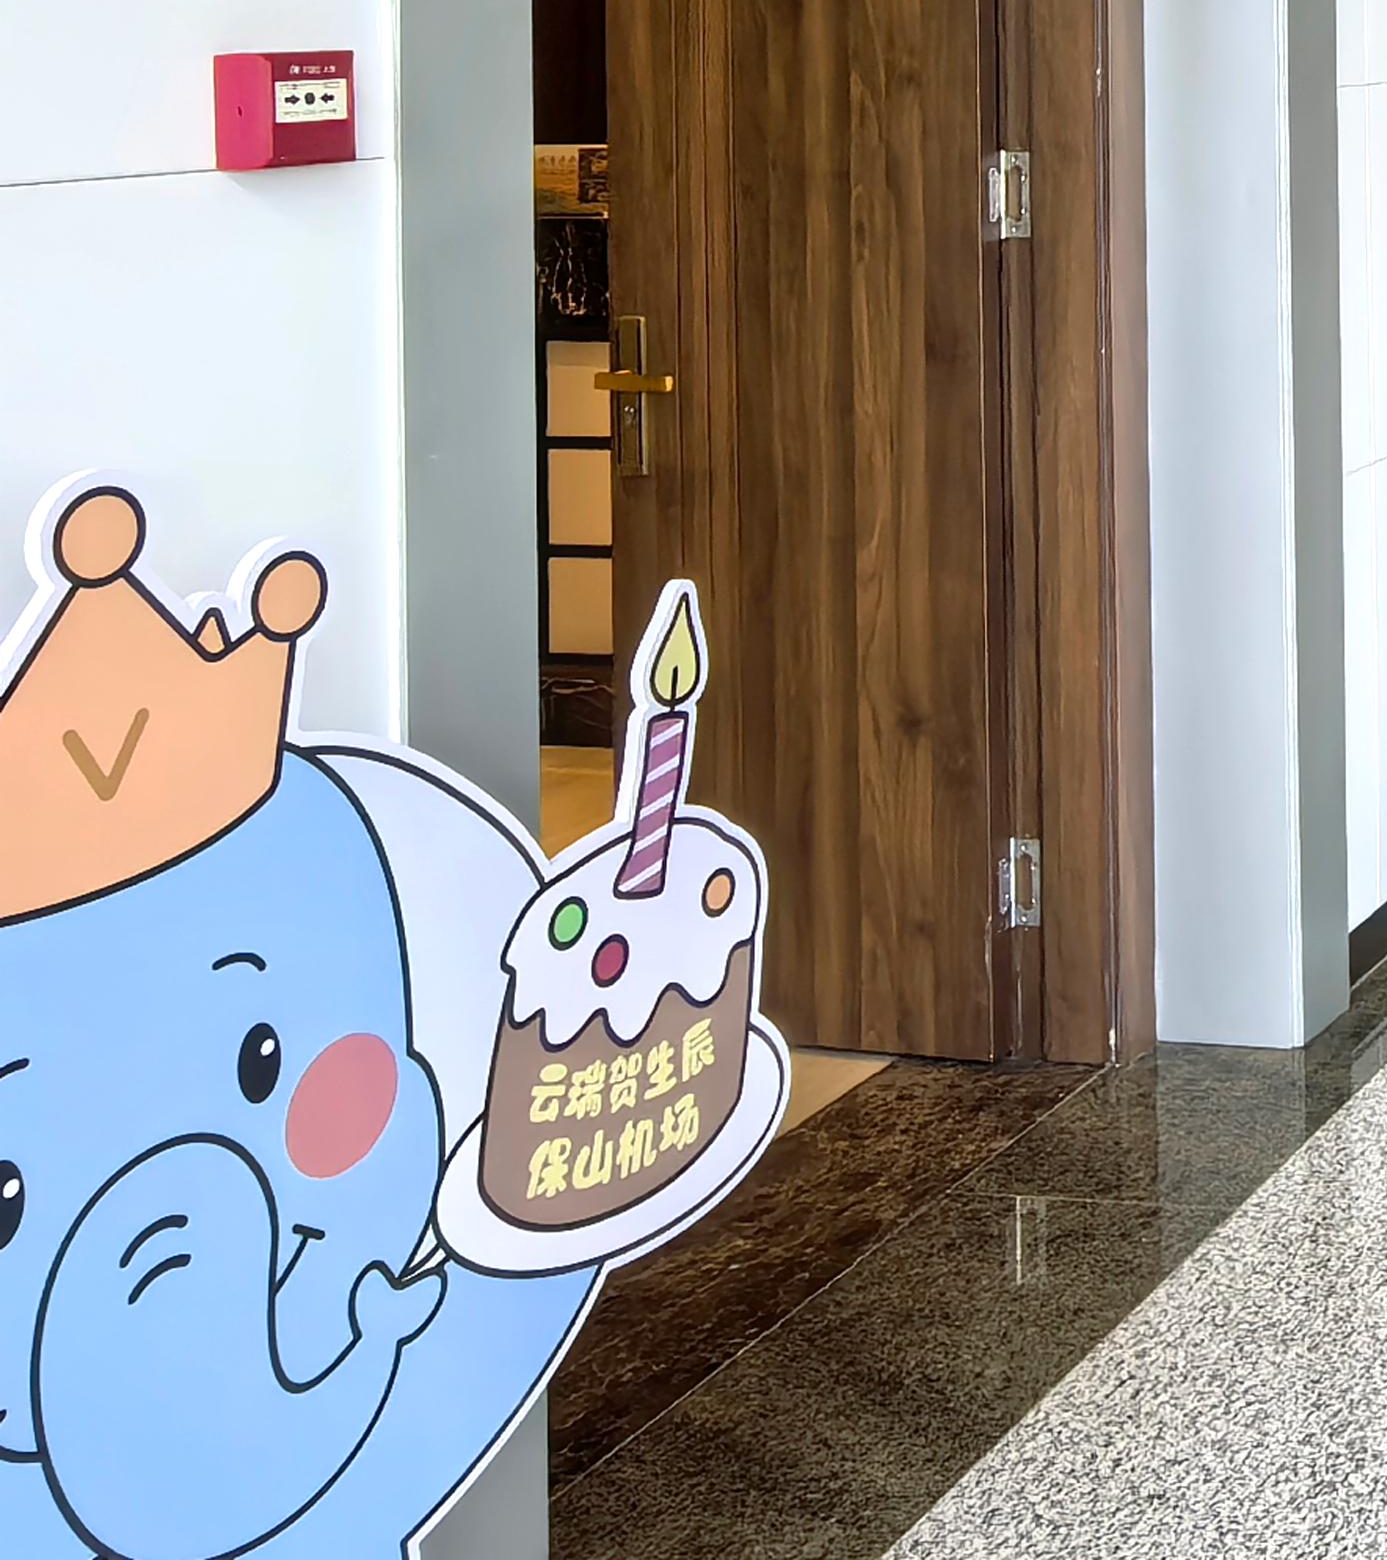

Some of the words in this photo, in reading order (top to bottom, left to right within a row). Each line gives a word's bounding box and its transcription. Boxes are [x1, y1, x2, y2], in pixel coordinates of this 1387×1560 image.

[529, 1018, 715, 1124] 云瑞贺生辰
[526, 1093, 700, 1200] 保山机场
